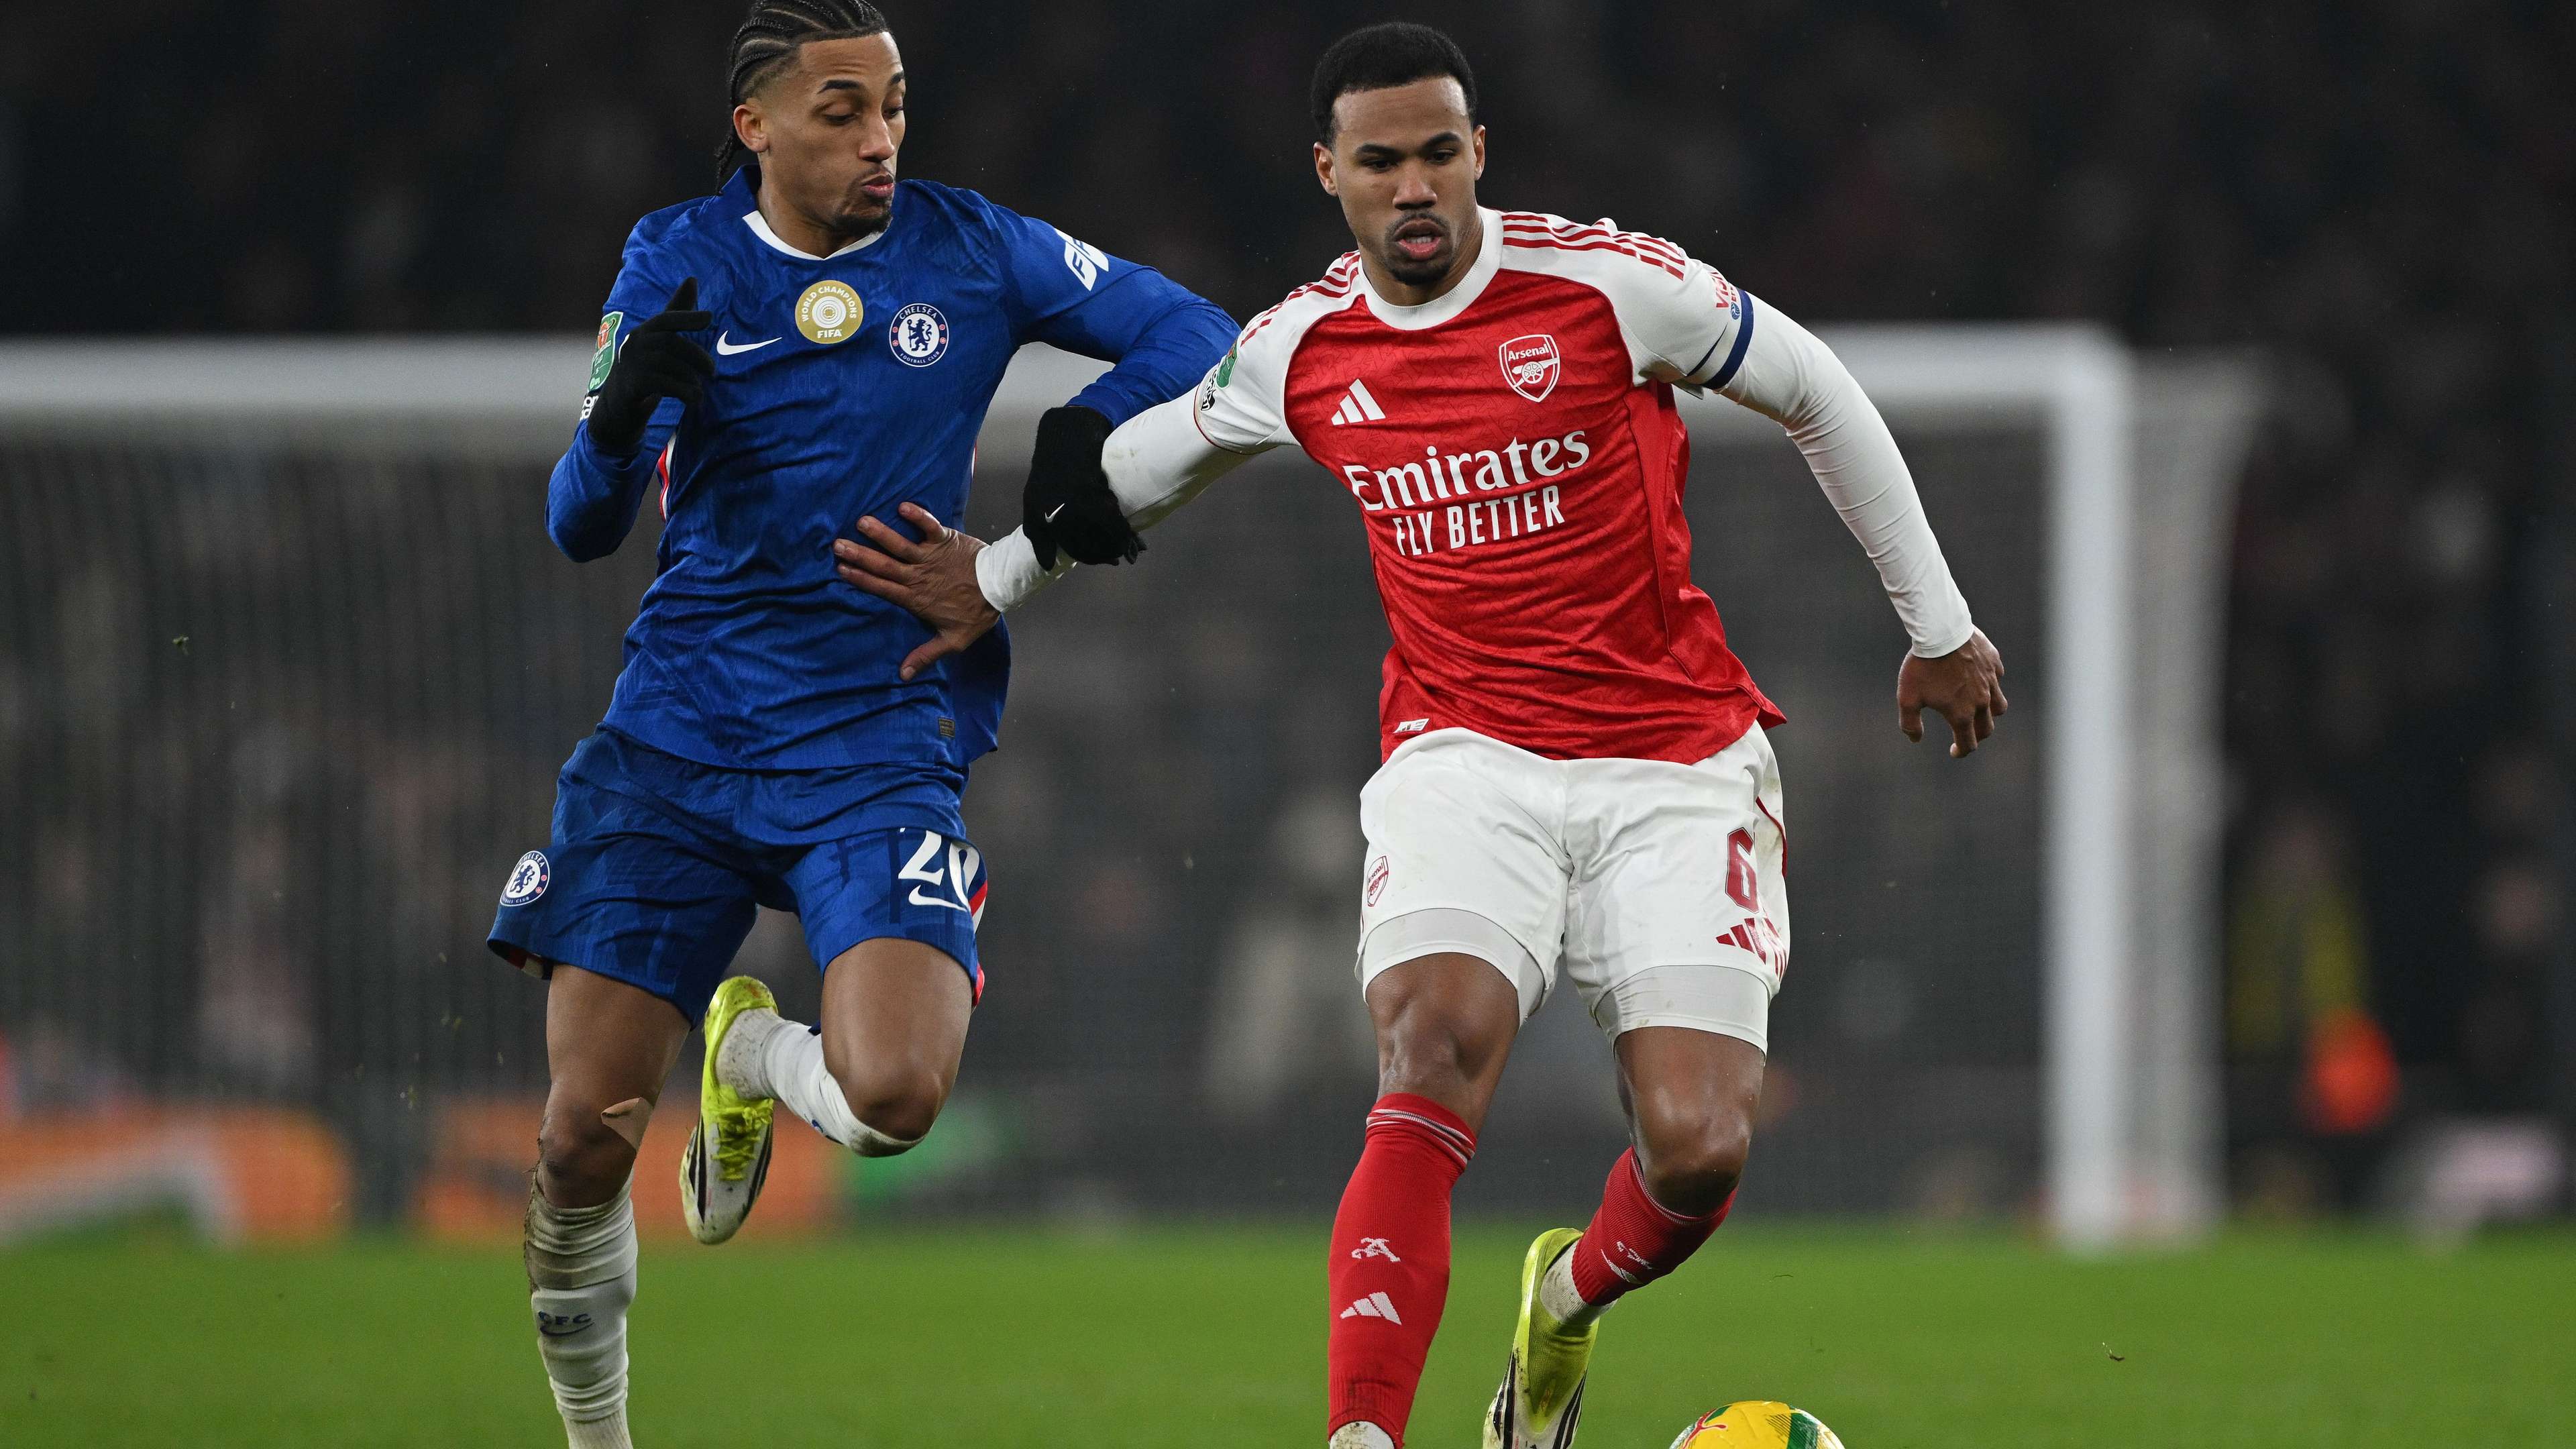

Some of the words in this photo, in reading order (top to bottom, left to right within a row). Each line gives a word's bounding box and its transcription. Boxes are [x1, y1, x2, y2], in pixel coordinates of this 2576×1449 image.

[802, 292, 817, 322] WORLD
[818, 286, 857, 319] CHAMPIONS
[899, 306, 938, 319] CHELSEA
[817, 329, 843, 339] FIFA
[900, 353, 926, 364] FOOTBALL
[928, 351, 940, 361] CLUB
[1508, 343, 1549, 362] Arsenal
[1342, 430, 1590, 511] Emirates
[1392, 511, 1434, 556] FLY
[1446, 485, 1565, 549] BETTER
[898, 830, 980, 913] 20
[1725, 826, 1760, 914] 6
